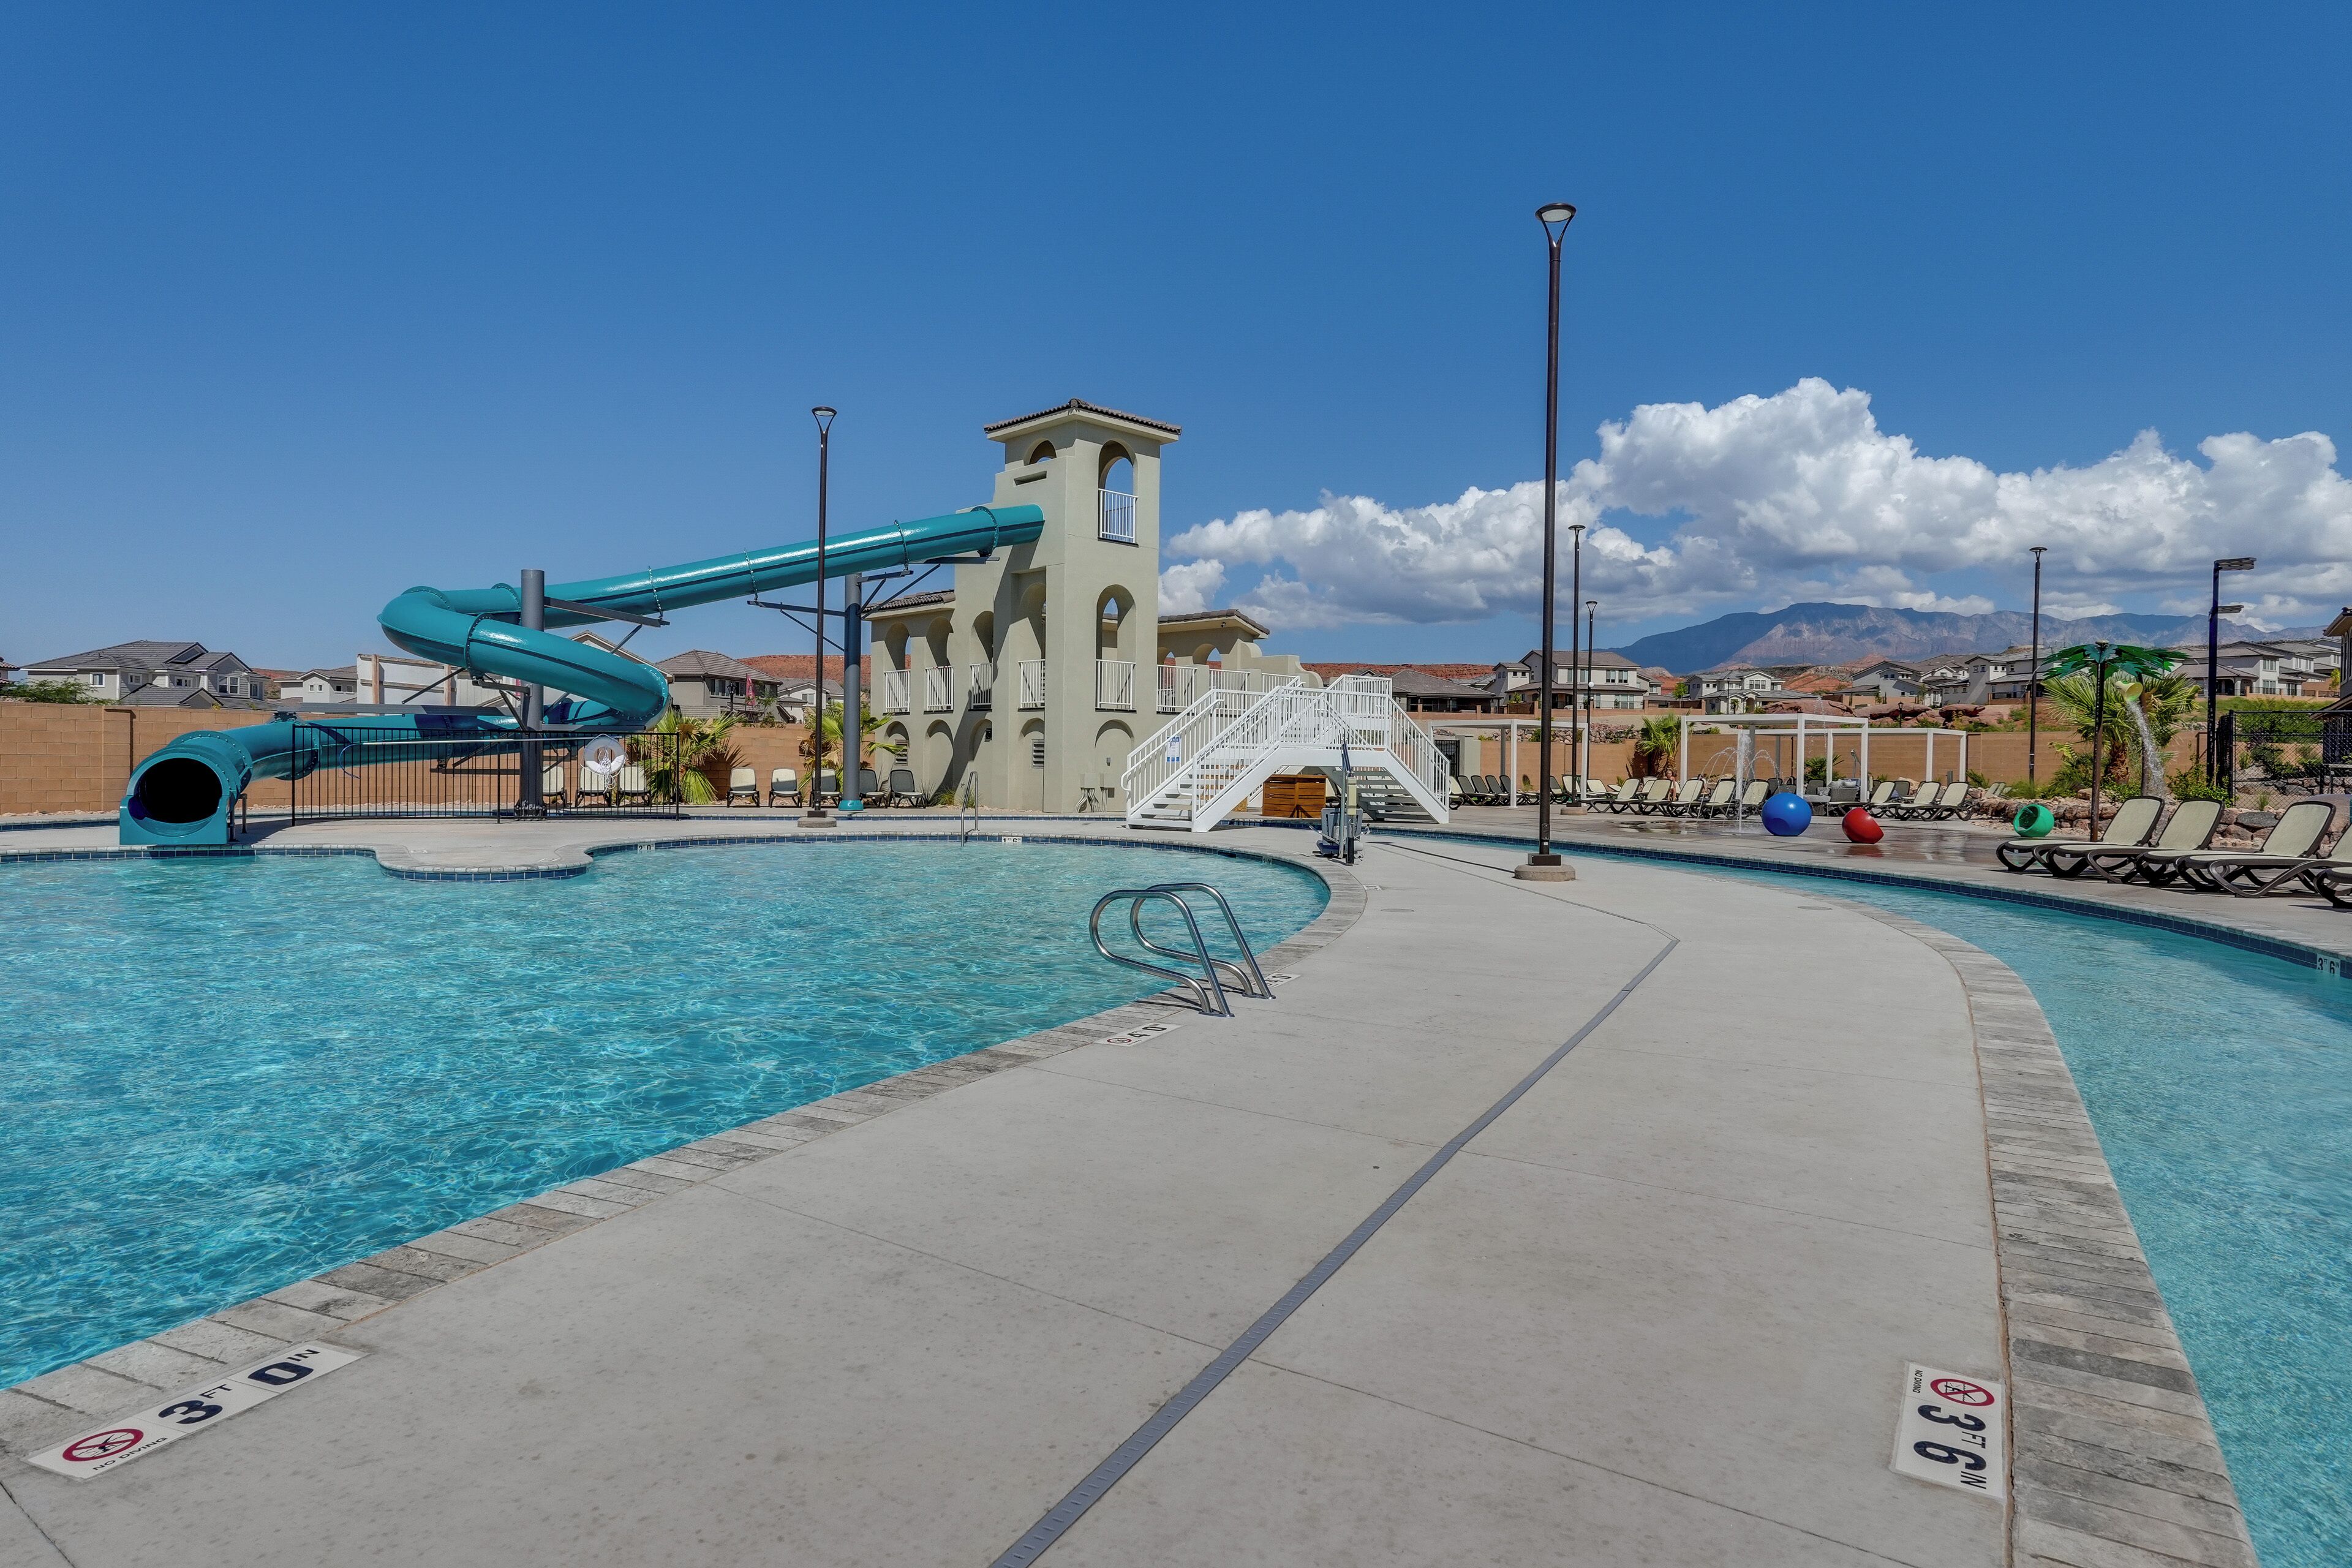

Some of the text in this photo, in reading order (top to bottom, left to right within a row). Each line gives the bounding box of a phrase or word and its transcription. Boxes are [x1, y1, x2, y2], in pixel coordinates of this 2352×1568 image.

[2318, 957, 2323, 971] 3
[2329, 960, 2335, 974] 6
[158, 1349, 321, 1424] 3 FT 0 IN
[1912, 1377, 1922, 1393] DIVING
[92, 1437, 168, 1471] NO DIVING
[1913, 1404, 1987, 1490] 3 FT 6 IN
